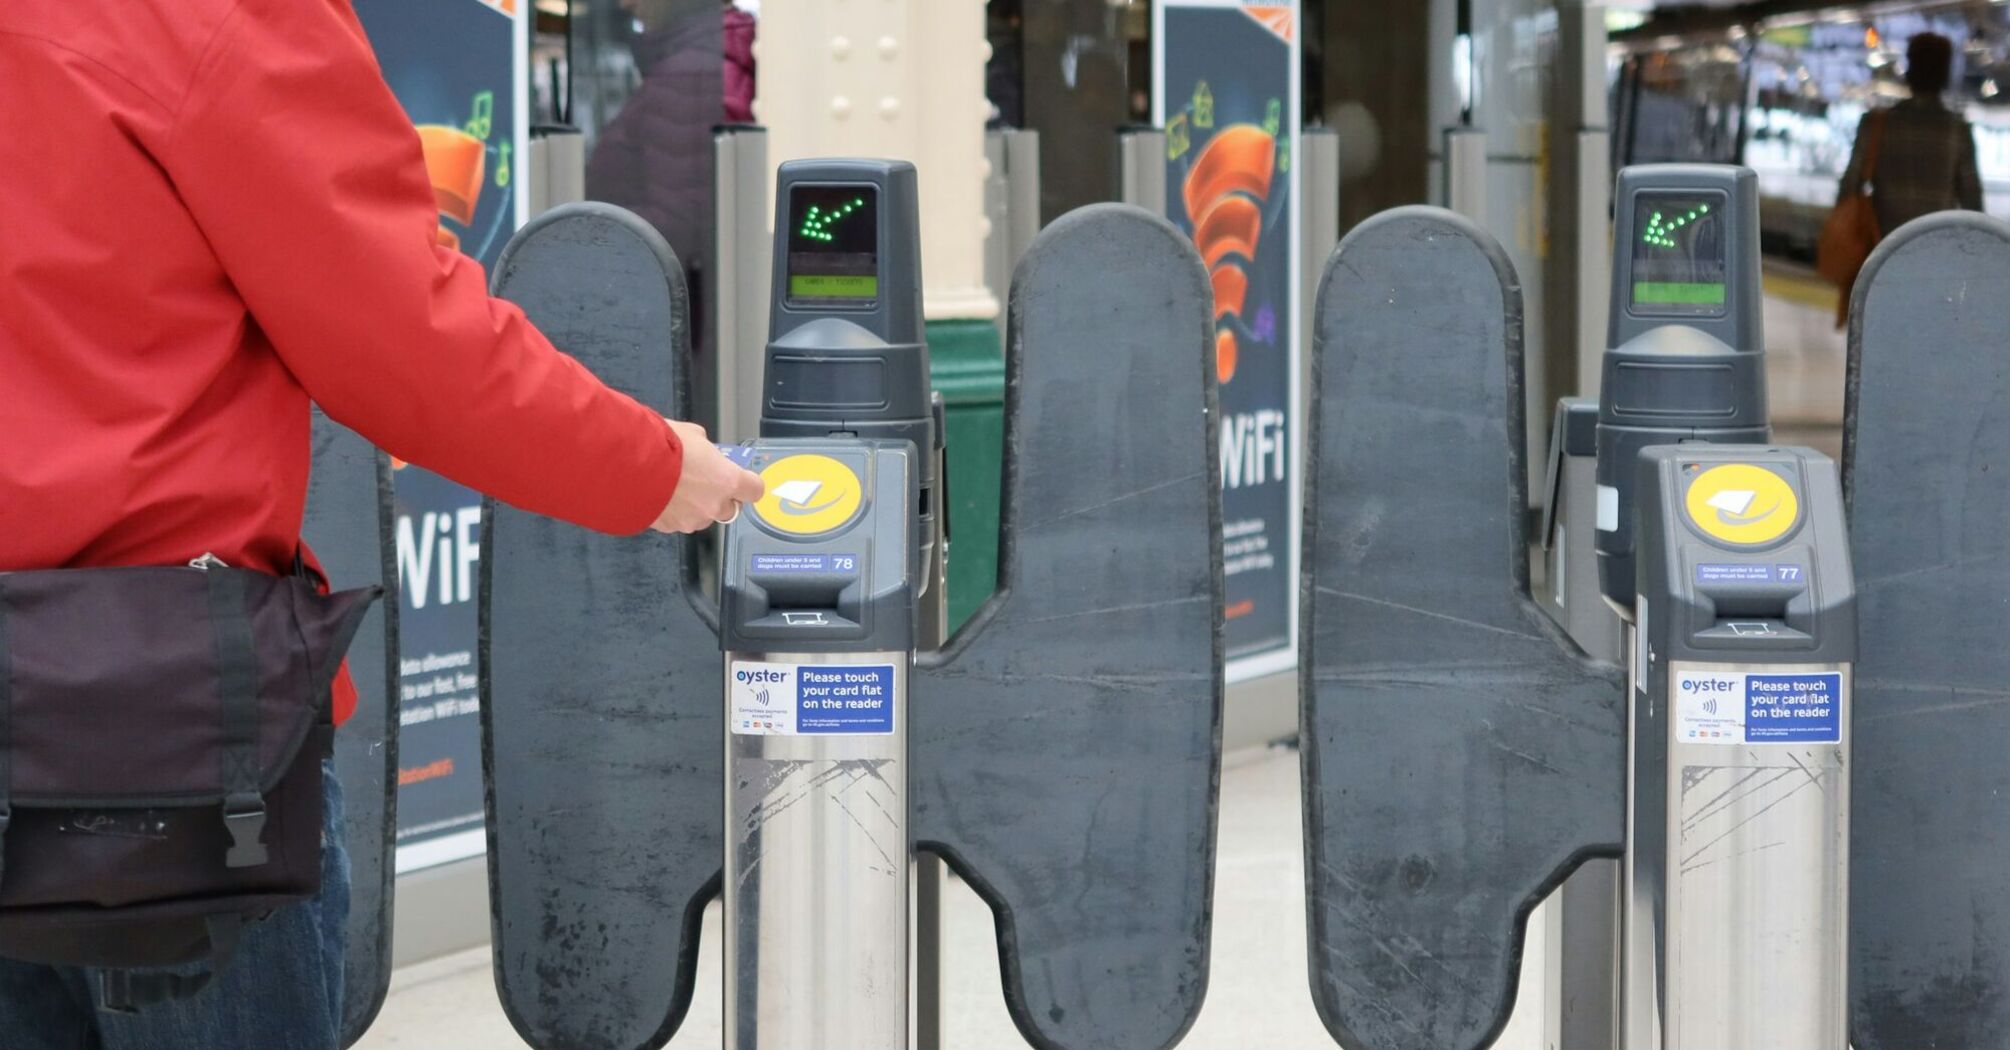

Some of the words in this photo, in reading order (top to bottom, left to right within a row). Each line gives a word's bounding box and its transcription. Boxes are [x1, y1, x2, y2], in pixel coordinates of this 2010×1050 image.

[1218, 409, 1285, 489] WiFi
[396, 506, 481, 609] WiF
[833, 558, 853, 570] 78
[1779, 568, 1799, 580] 77
[736, 669, 786, 685] oyster
[803, 672, 842, 682] Please
[845, 672, 879, 682] touch
[803, 687, 830, 697] your
[833, 685, 858, 696] card
[862, 685, 882, 696] flat
[1682, 678, 1736, 694] oyster
[1752, 681, 1790, 692] Please
[1793, 681, 1826, 691] touch
[803, 700, 818, 708] on
[822, 698, 842, 708] the
[846, 698, 882, 708] reader
[1751, 696, 1779, 706] your
[1782, 694, 1806, 704] card
[1810, 694, 1830, 704] flat
[1752, 709, 1767, 718] on
[1770, 708, 1791, 718] the
[1794, 707, 1830, 718] reader
